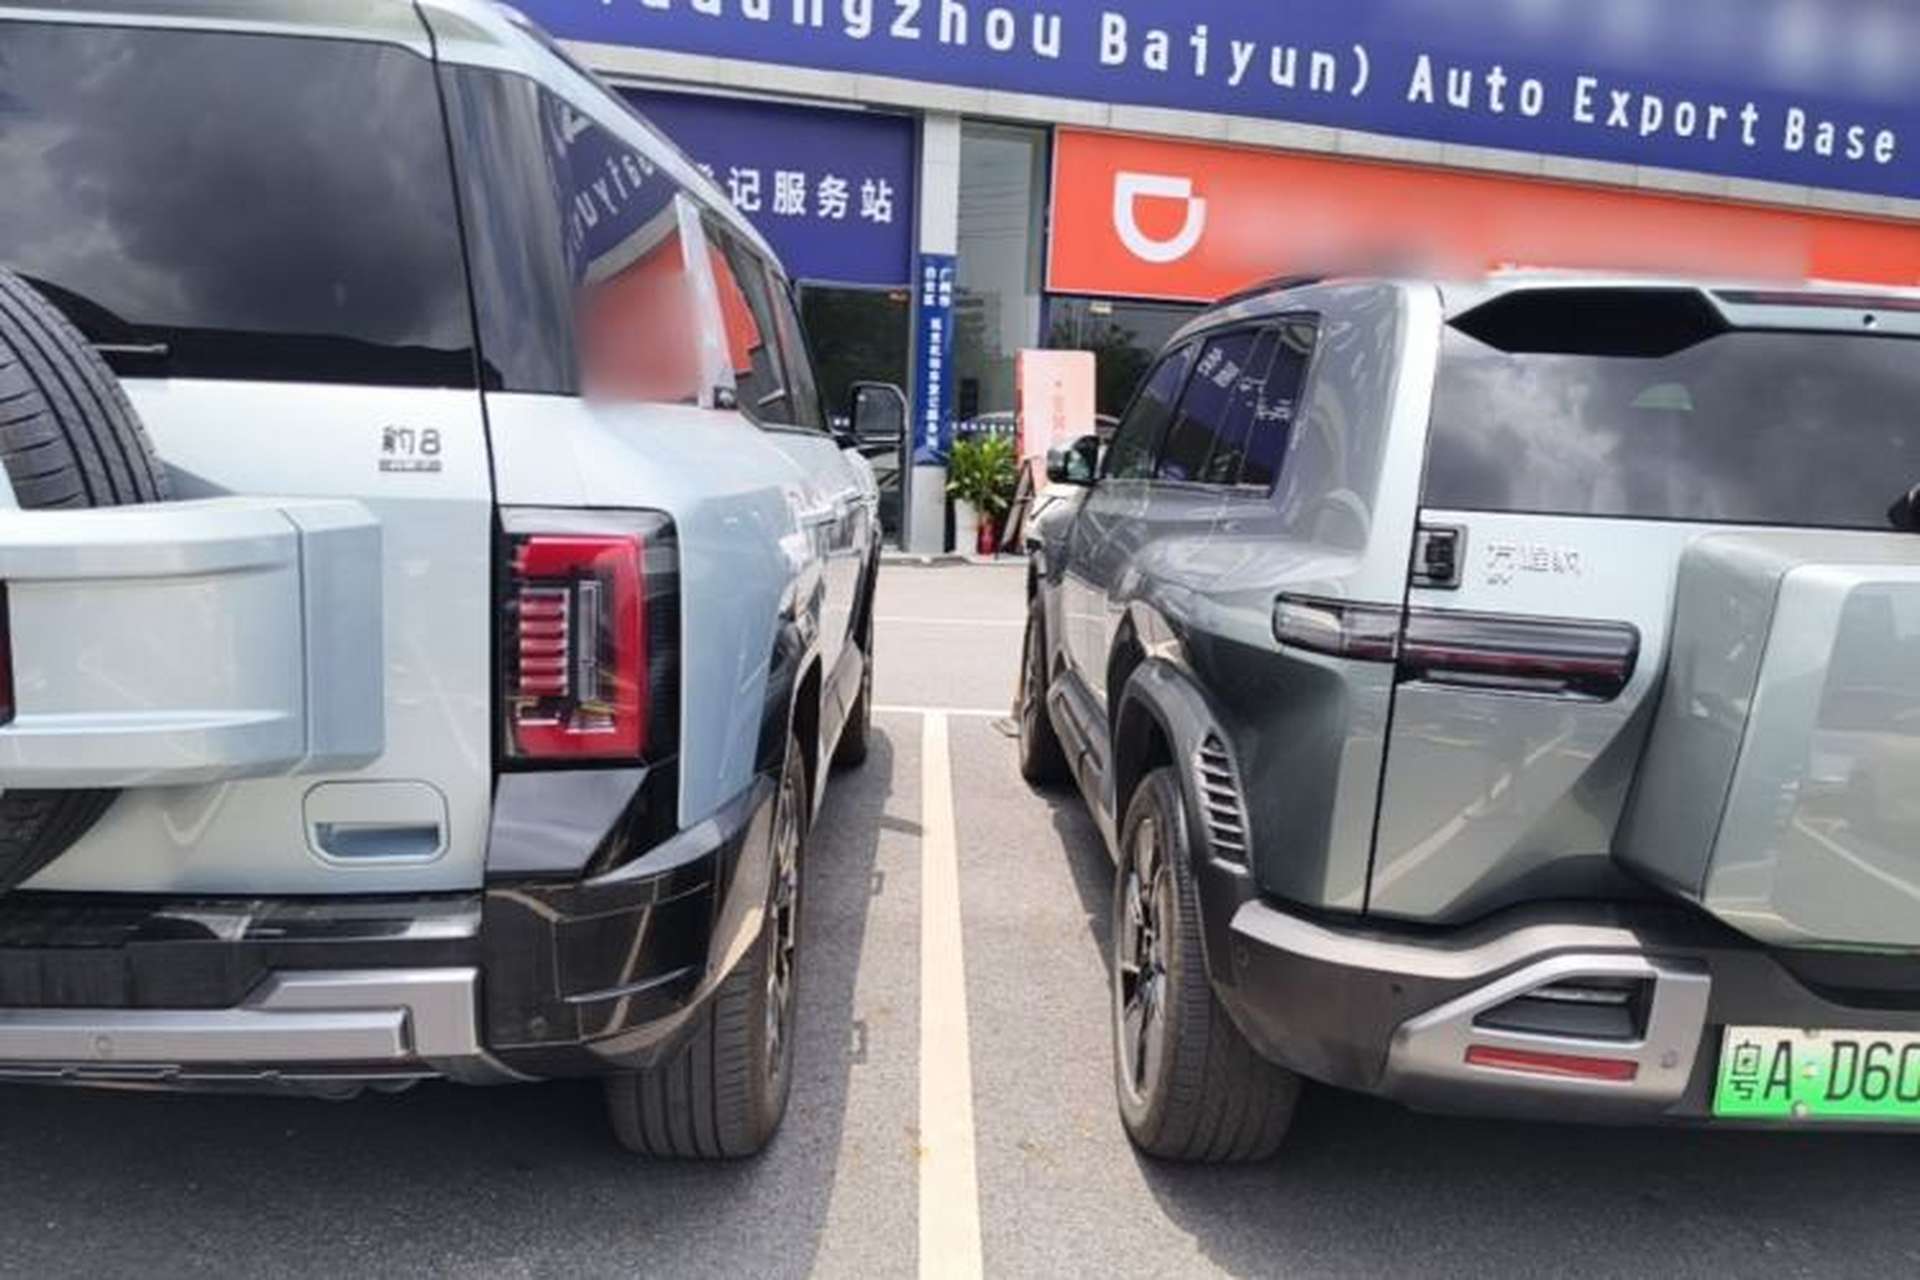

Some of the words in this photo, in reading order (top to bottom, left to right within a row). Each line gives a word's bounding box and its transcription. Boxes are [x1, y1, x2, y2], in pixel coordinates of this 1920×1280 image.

[1100, 11, 1370, 97] Baiyun)
[1407, 54, 1543, 118] Auto
[1573, 76, 1758, 146] Export
[1784, 108, 1896, 164] Base
[697, 163, 894, 224] 记服务站
